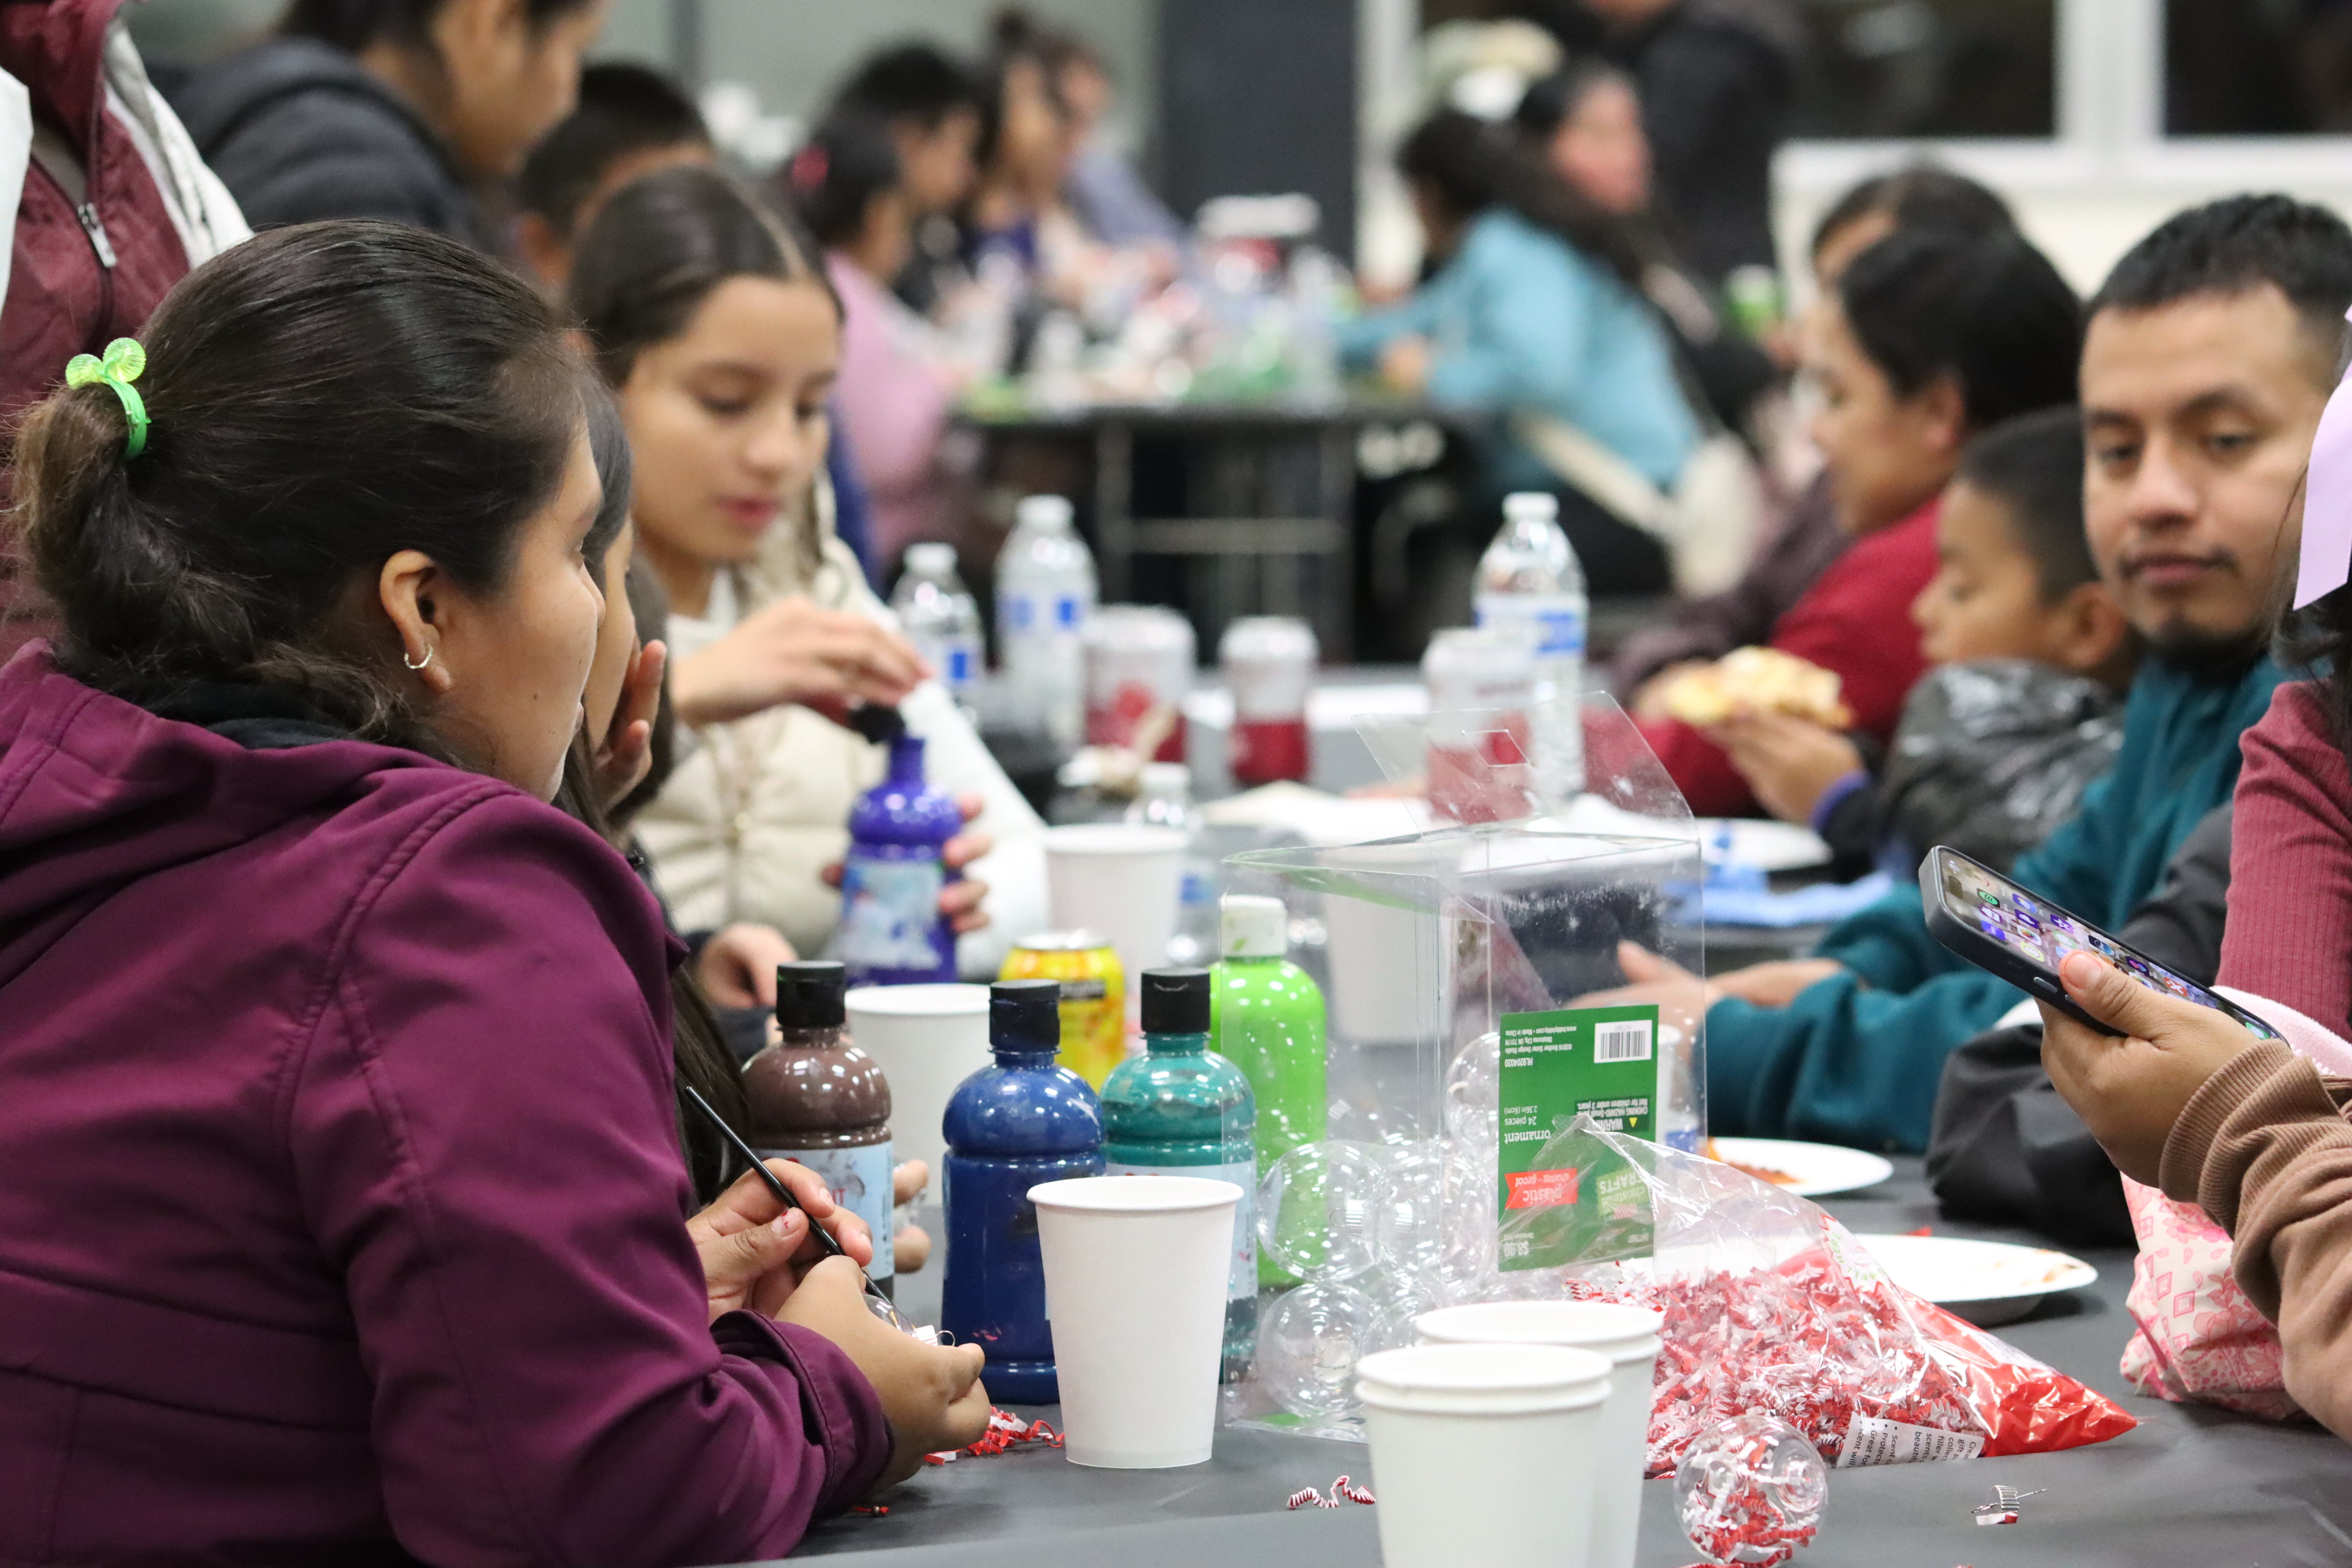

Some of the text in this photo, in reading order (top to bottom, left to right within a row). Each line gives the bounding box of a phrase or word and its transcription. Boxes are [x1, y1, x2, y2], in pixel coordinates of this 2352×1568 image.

[1504, 1057, 1533, 1067] HL9204020
[1611, 1099, 1631, 1107] children
[1504, 1106, 1520, 1115] (6cm)
[1504, 1115, 1537, 1126] 24 pieces
[1504, 1130, 1550, 1144] ornament
[1515, 1174, 1537, 1187] proof
[1522, 1183, 1562, 1204] plastic
[1861, 1430, 1877, 1466] Great for
[1873, 1433, 1887, 1465] Protects
[1889, 1435, 1898, 1458] Scent
[1922, 1433, 1932, 1459] scents
[1936, 1436, 1945, 1454] filler
[1957, 1439, 1965, 1452] gift
[1849, 1452, 1858, 1465] will
